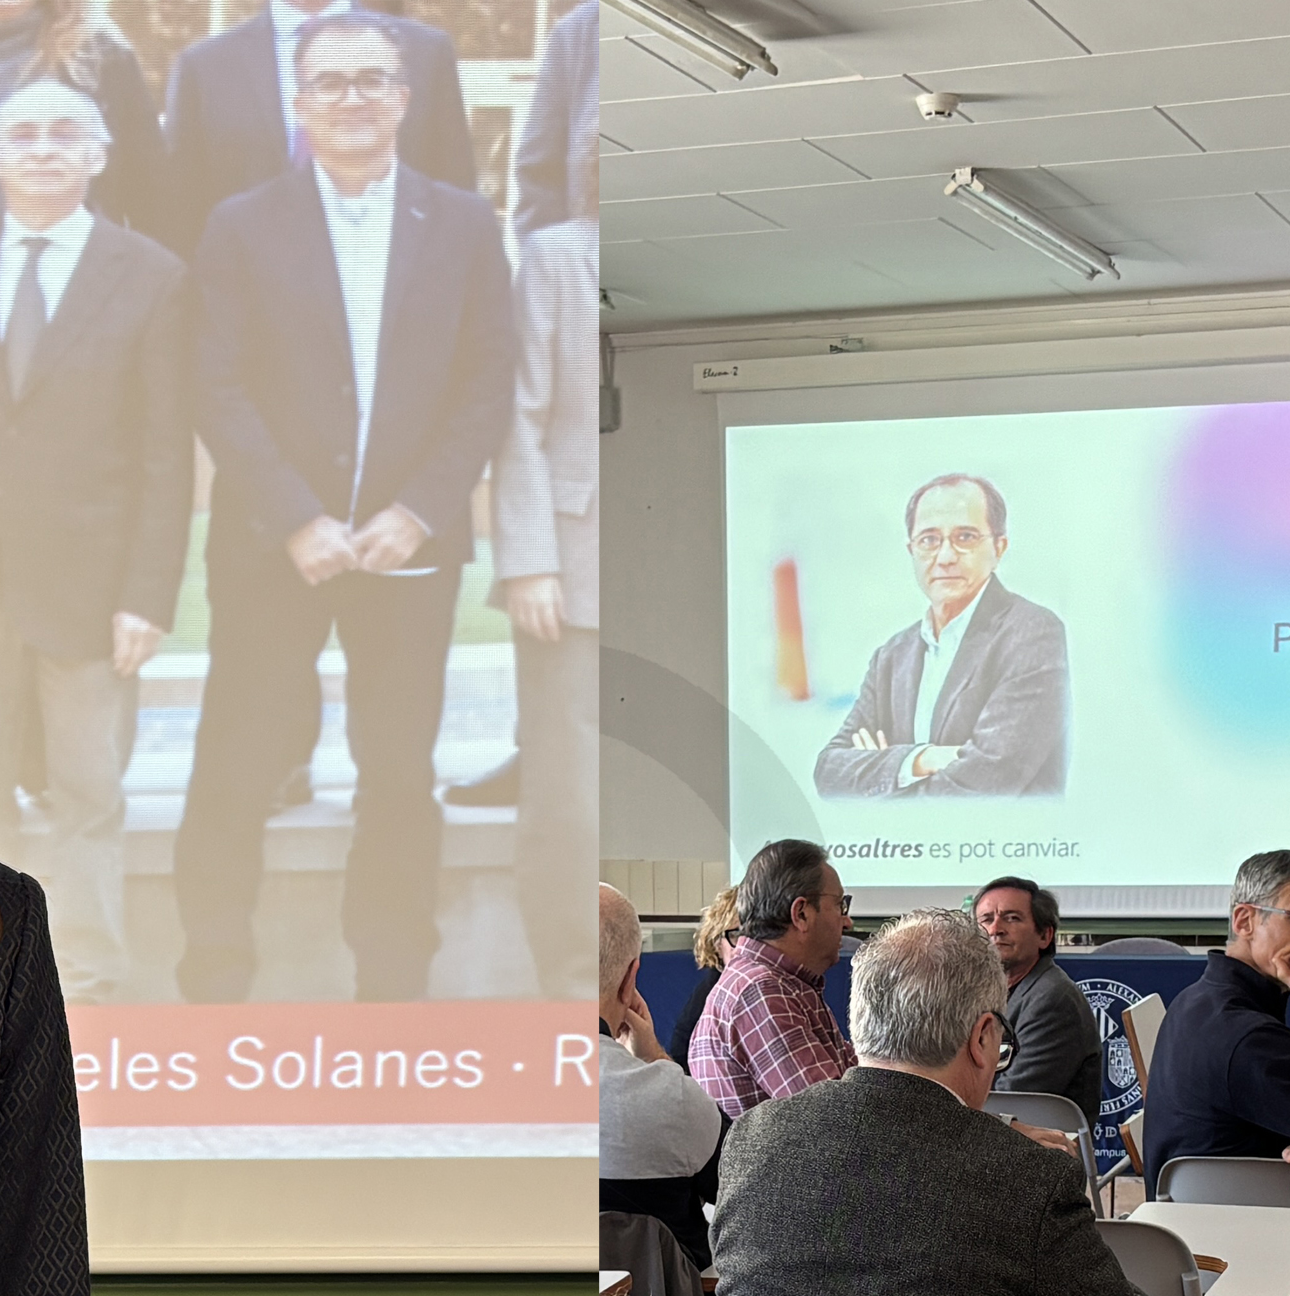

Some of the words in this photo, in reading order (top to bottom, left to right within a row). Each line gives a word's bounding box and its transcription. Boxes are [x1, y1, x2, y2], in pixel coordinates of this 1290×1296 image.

[928, 842, 951, 858] es
[959, 839, 995, 863] pot
[1002, 837, 1081, 858] canviar.
[225, 1034, 484, 1090] Solanes
[554, 1033, 594, 1087] R
[1093, 1148, 1127, 1159] ampus
